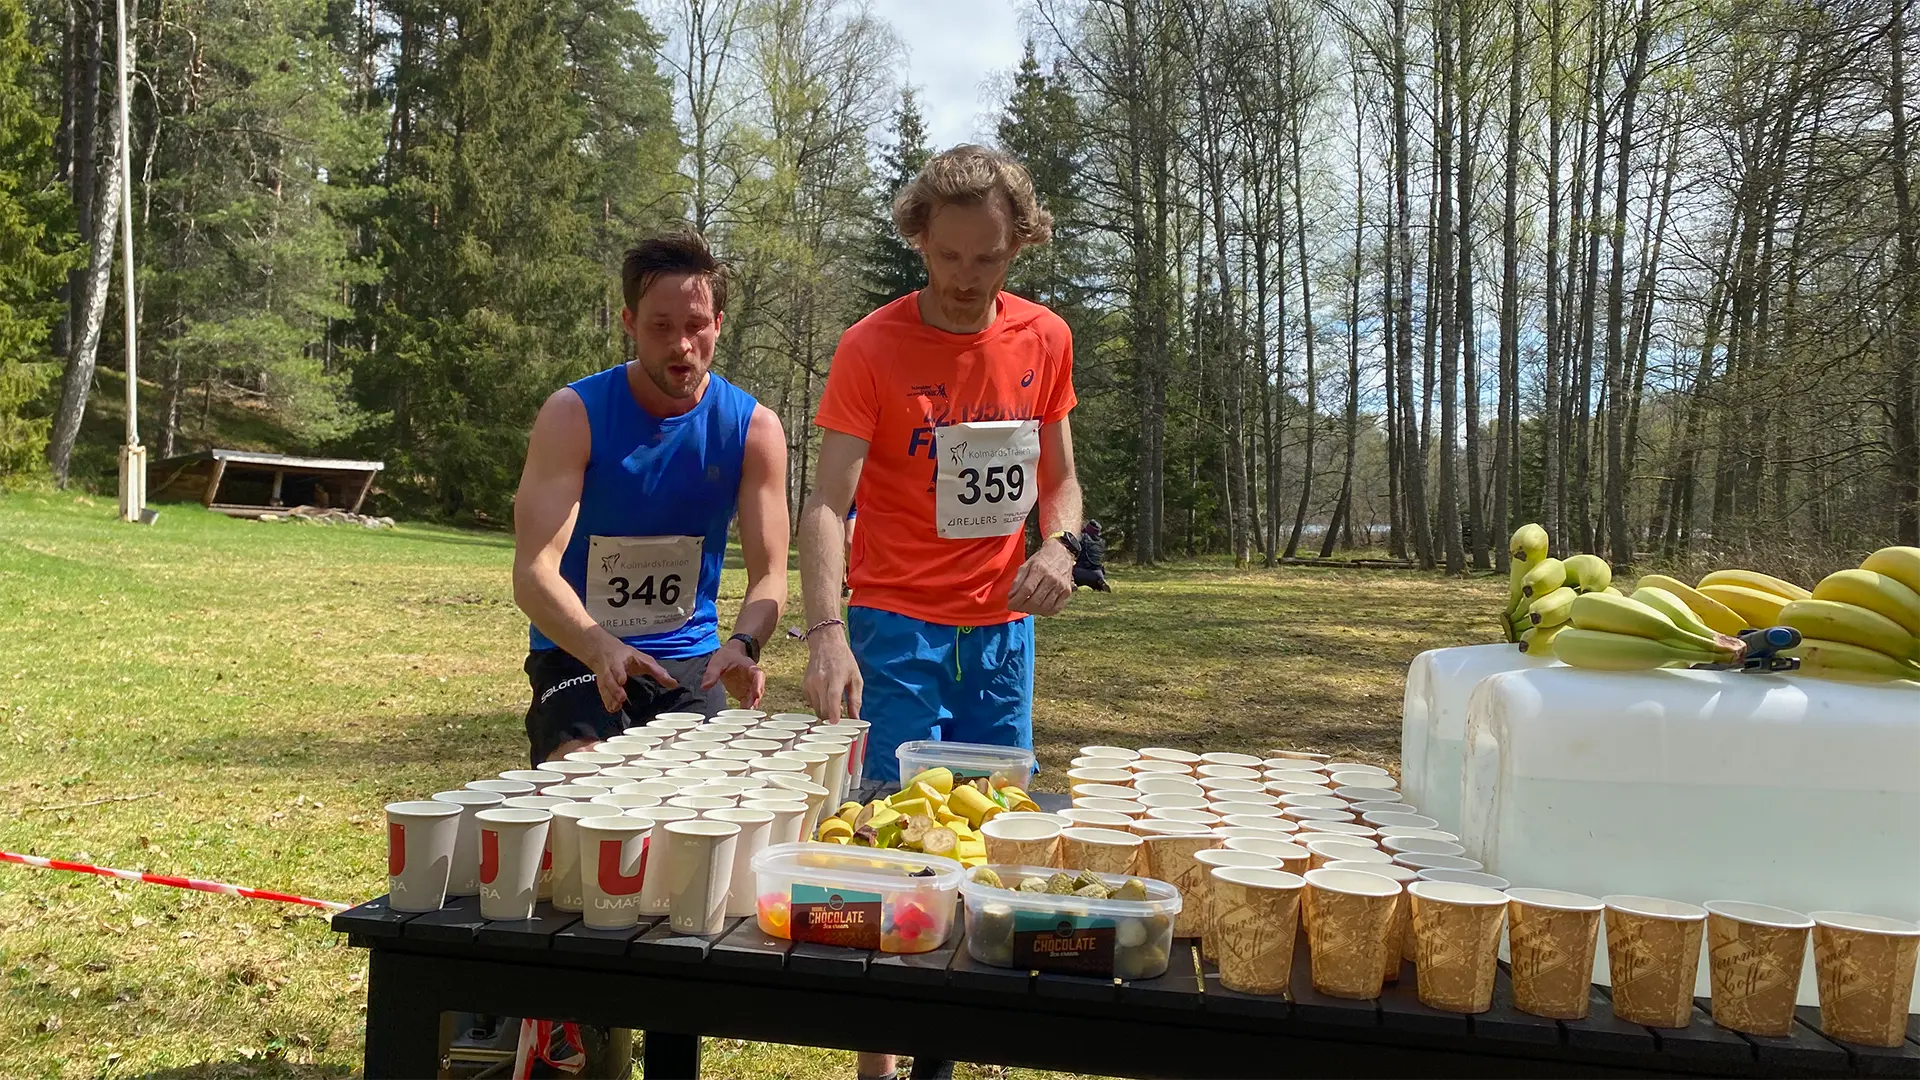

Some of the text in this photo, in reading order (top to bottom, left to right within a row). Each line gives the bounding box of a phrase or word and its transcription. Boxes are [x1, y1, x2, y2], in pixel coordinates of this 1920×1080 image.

[957, 464, 1025, 505] 359
[956, 516, 998, 526] REJLERS
[607, 573, 681, 608] 346
[604, 617, 648, 627] REJLERS
[808, 911, 865, 924] CHOCOLATE
[1033, 938, 1096, 953] CHOCOLATE
